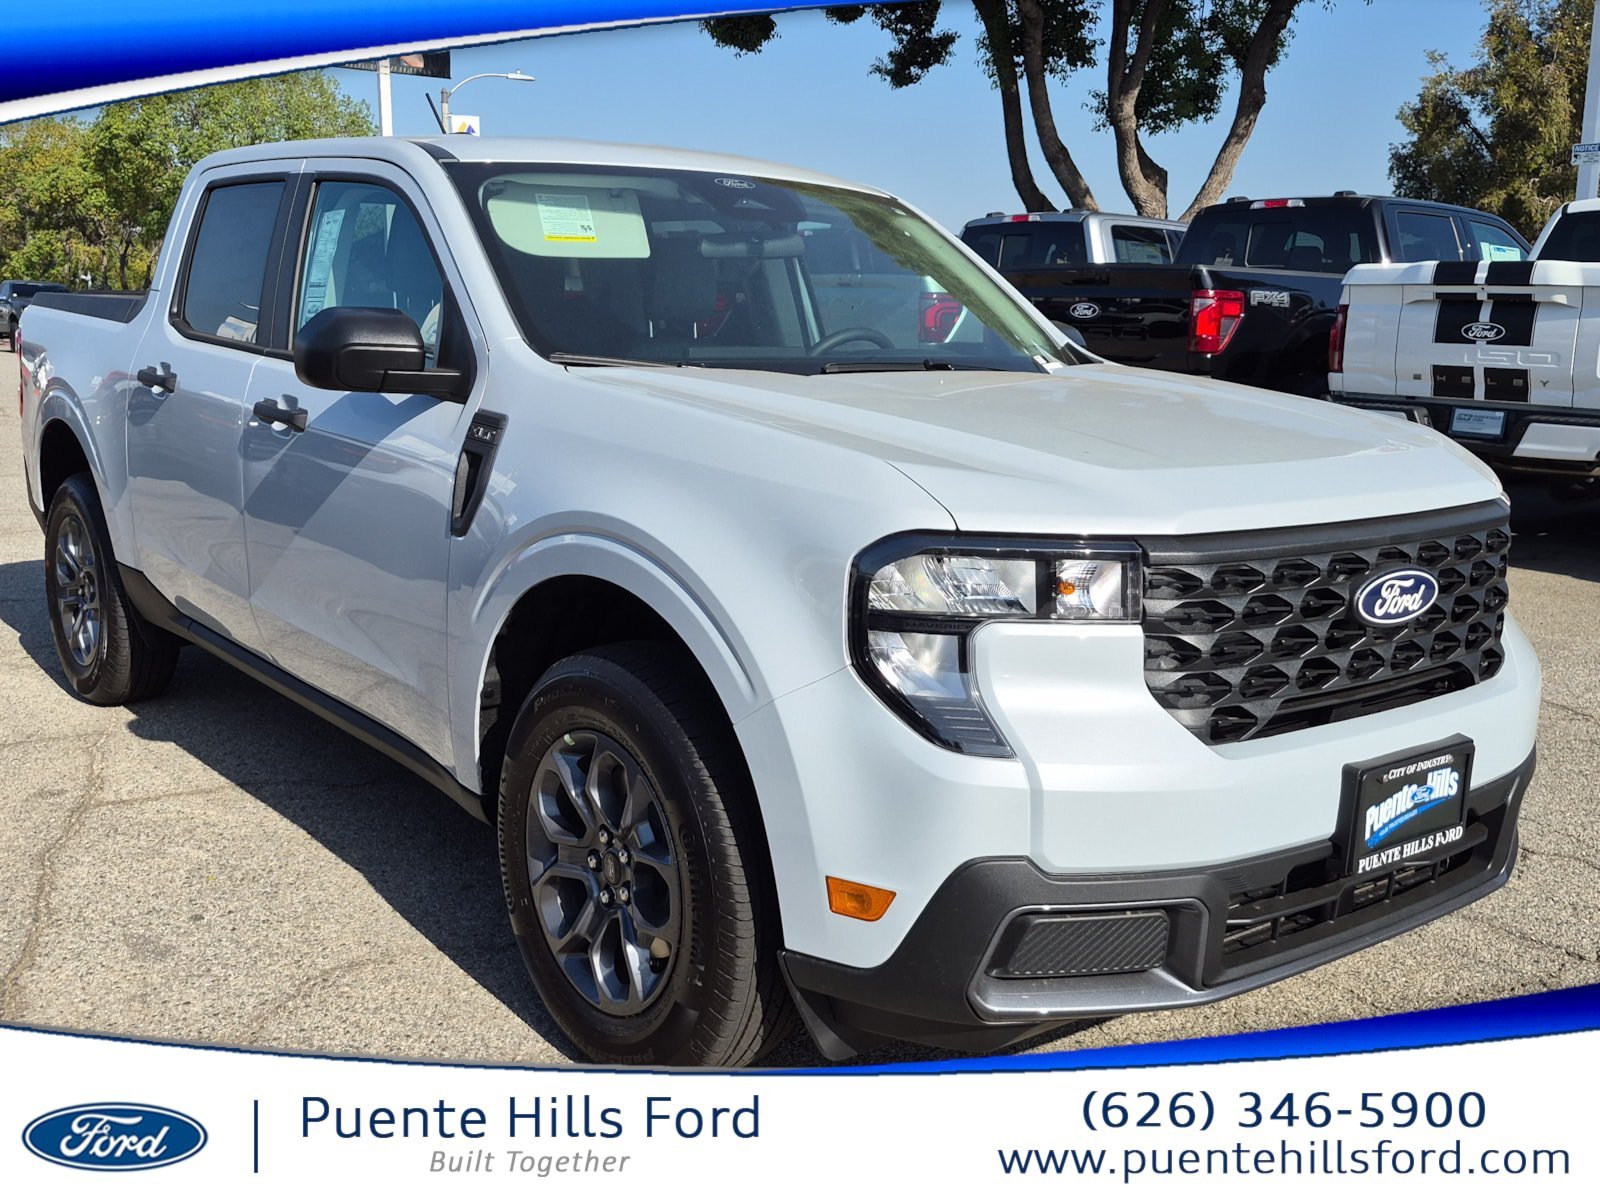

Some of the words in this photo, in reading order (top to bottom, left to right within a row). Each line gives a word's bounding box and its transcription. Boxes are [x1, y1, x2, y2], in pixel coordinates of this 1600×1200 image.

[1250, 290, 1290, 308] FX4
[1468, 324, 1497, 338] Ford
[1373, 578, 1426, 617] Ford
[1388, 766, 1407, 780] CITY
[1406, 763, 1417, 775] OF
[1364, 784, 1418, 841] Puente
[1426, 767, 1459, 801] Hills
[1357, 847, 1402, 874] PUENTE
[1402, 833, 1434, 858] HILLS
[1434, 825, 1464, 849] FORD
